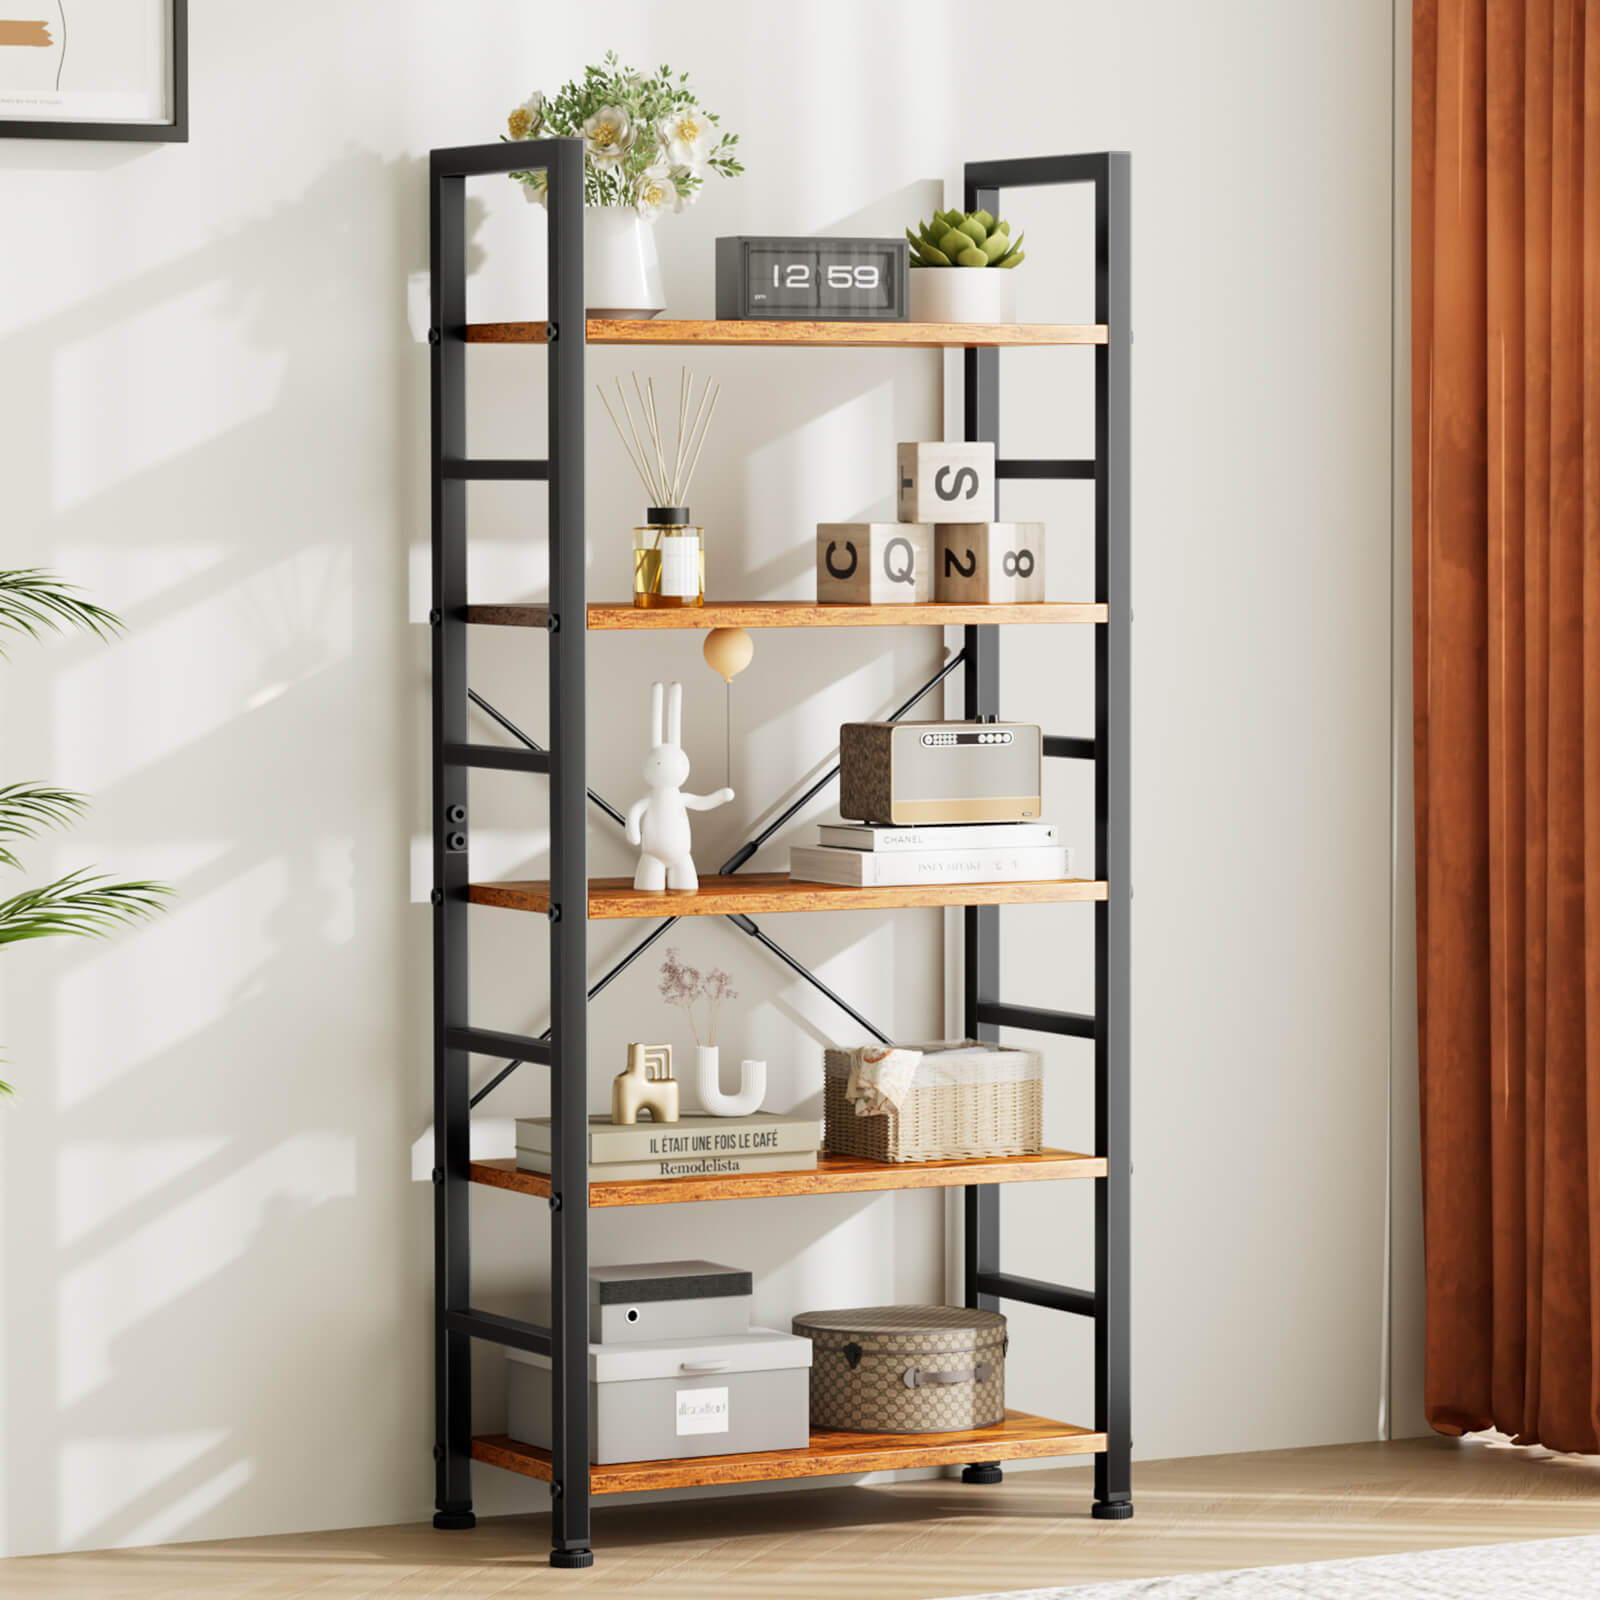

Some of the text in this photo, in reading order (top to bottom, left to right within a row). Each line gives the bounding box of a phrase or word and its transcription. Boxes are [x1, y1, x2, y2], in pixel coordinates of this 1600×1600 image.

[773, 264, 880, 289] 12 59
[935, 465, 979, 501] S
[826, 541, 857, 579] C
[884, 537, 915, 586] Q
[945, 548, 976, 578] 2
[1002, 549, 1035, 578] 8
[883, 835, 924, 845] CHANEL
[650, 1129, 778, 1153] IL ÉTAIT UNE FOIS LE CAFÉ
[660, 1158, 740, 1175] Remodelista
